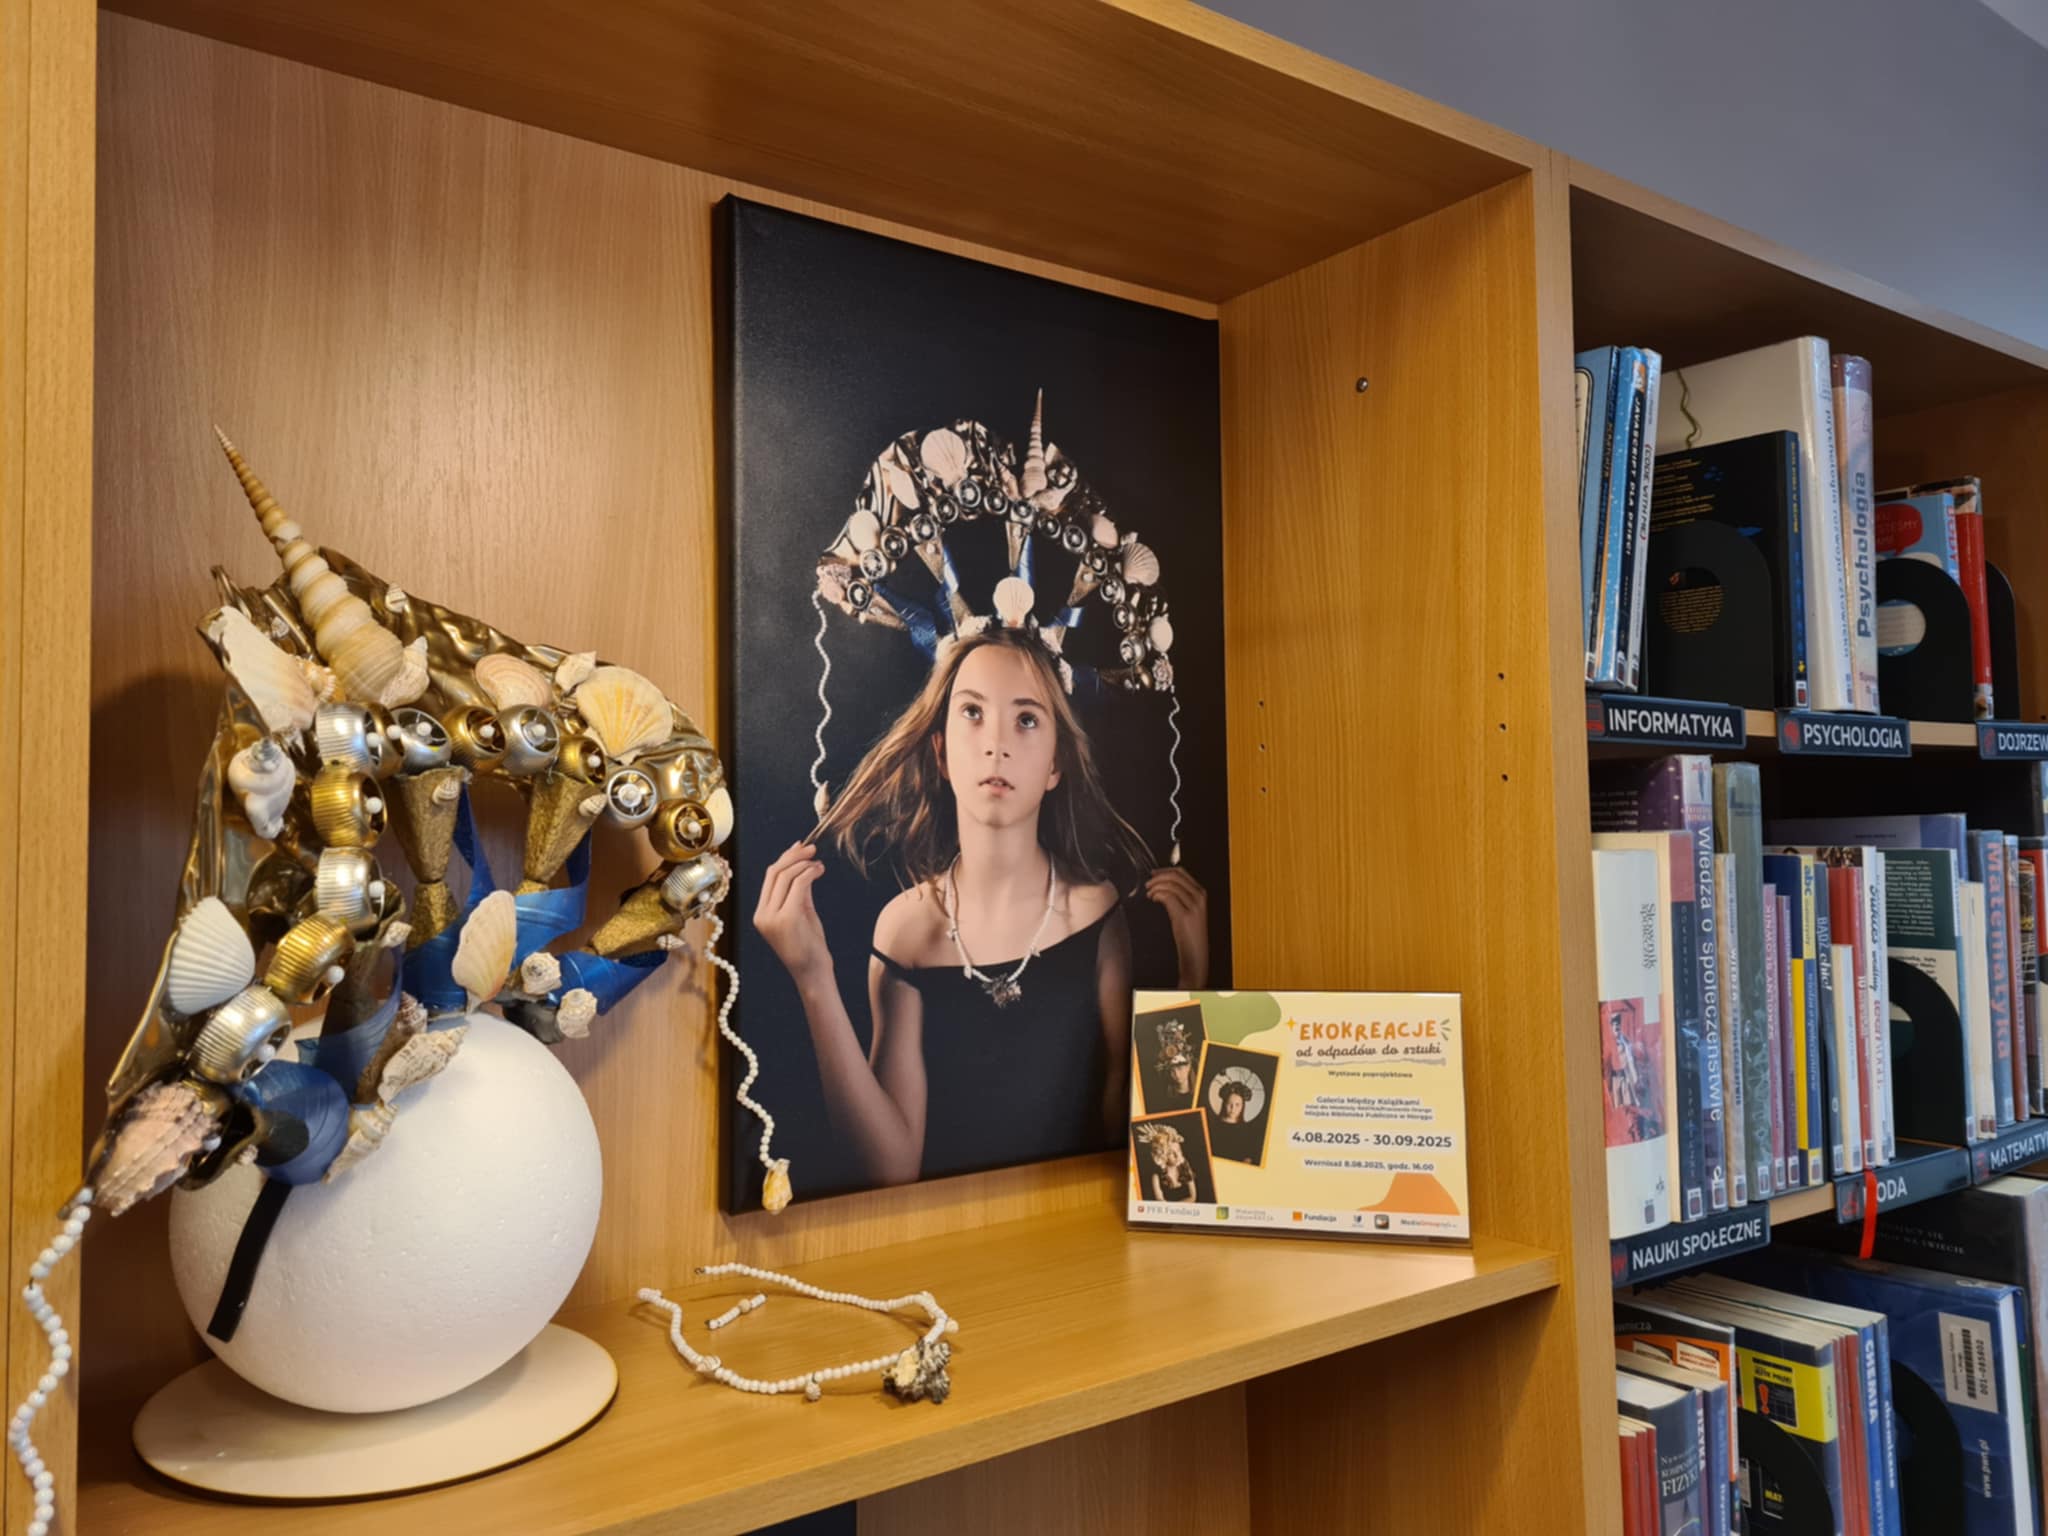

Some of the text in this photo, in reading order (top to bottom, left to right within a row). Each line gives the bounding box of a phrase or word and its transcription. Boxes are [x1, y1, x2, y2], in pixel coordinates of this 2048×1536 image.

[1631, 397, 1641, 476] JAVASCRIPT
[1625, 511, 1634, 555] DZIECI
[1853, 472, 1872, 638] Psychologia
[1609, 708, 1734, 738] INFORMATYKA
[1803, 724, 1904, 749] PSYCHOLOGIA
[1698, 826, 1713, 909] Wiedza
[1804, 865, 1814, 896] abc
[1701, 918, 1713, 932] o
[1869, 885, 1879, 944] Sukces
[1647, 902, 1657, 968] Słownik
[1986, 842, 2010, 1059] Matematyka
[1728, 948, 1741, 1001] WIEDZA
[1821, 952, 1833, 991] chic!
[1299, 1019, 1437, 1042] EKOKREACJE
[1296, 1041, 1442, 1059] od odpadów do sztuki
[1328, 1070, 1361, 1078] Wystawa
[1316, 1096, 1421, 1107] Galeria Między Książkami
[1292, 1131, 1360, 1145] 4.08.2025
[1373, 1134, 1453, 1148] 30.09.2025
[1304, 1158, 1342, 1167] Wernisaż
[1388, 1161, 1411, 1171] godz.
[1412, 1163, 1434, 1171] 16.00
[1863, 1176, 1908, 1204] ODA
[1304, 1212, 1337, 1224] Fundacja
[1632, 1218, 1762, 1271] NAUKI SPOŁECZNE
[1864, 1338, 1878, 1425] CHEMIA
